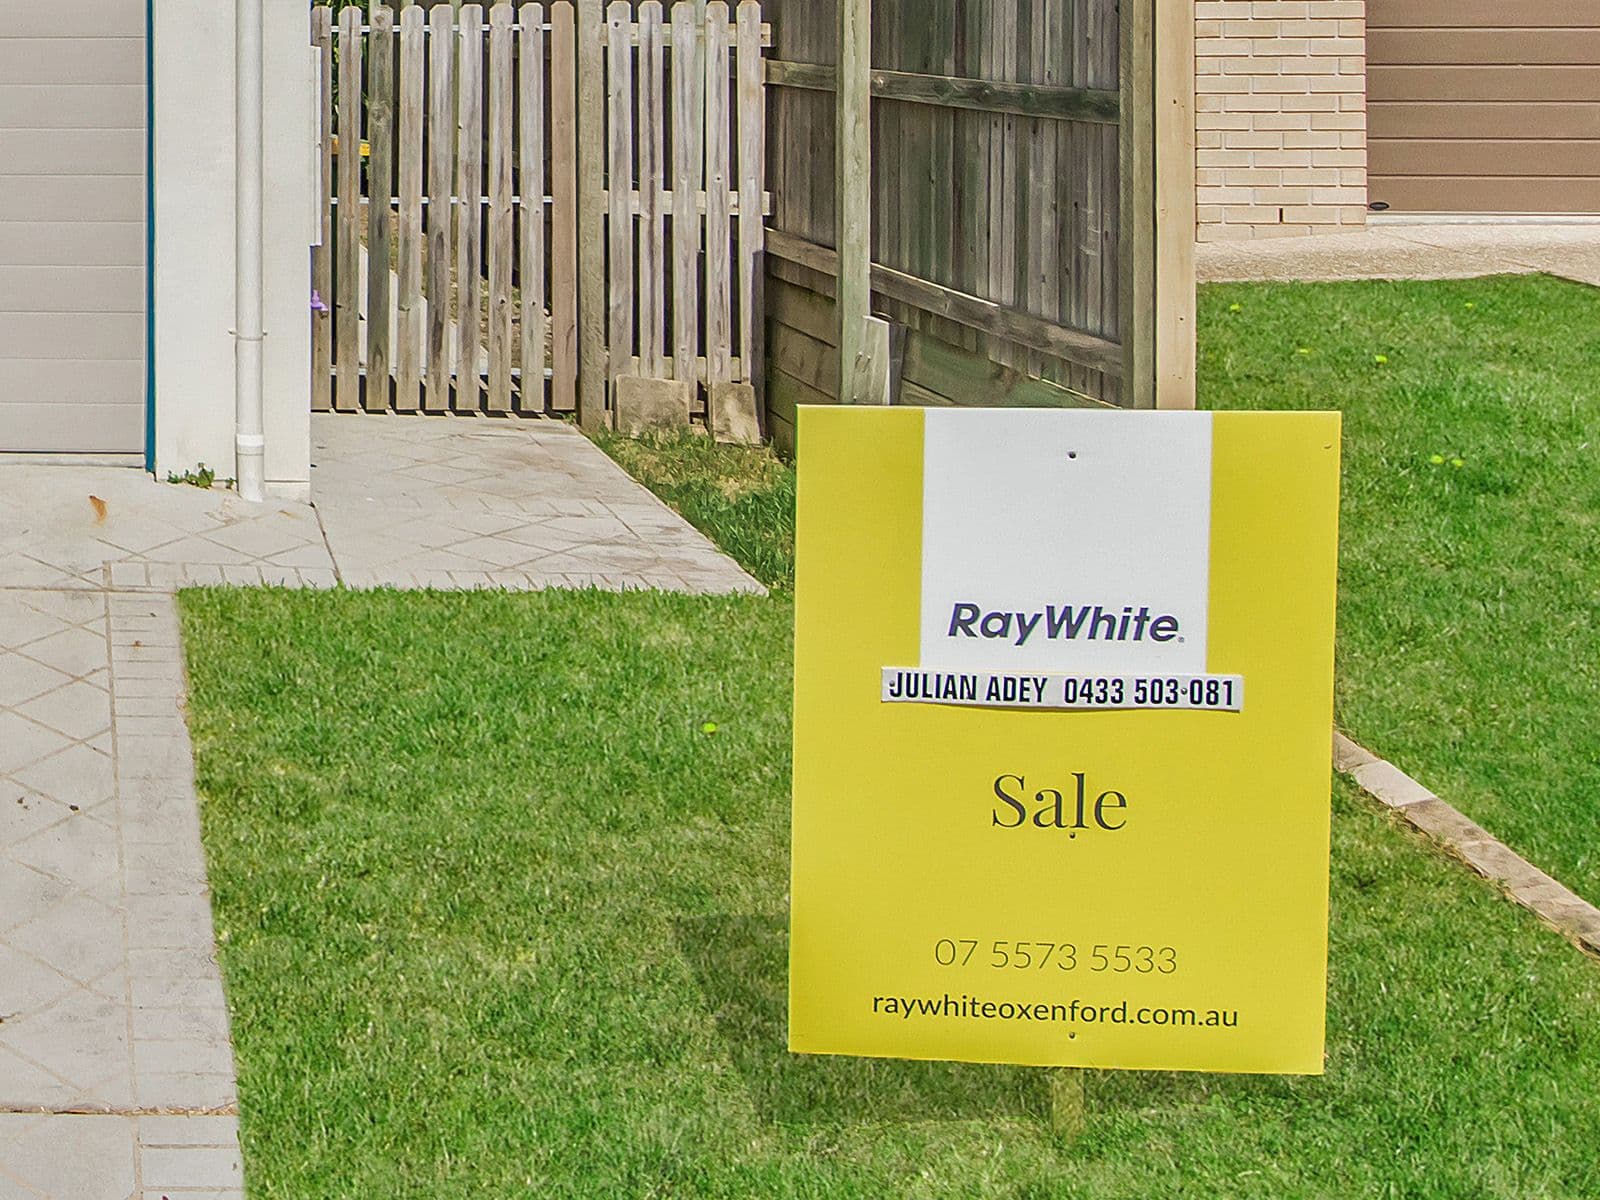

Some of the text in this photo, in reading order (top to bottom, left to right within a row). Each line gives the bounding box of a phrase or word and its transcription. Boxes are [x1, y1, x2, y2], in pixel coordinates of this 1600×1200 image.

[889, 672, 977, 700] JULIAN
[986, 676, 1048, 703] ADEY
[1064, 678, 1124, 704] 0433
[991, 773, 1127, 831] Sale
[935, 939, 1177, 974] 07 5573 5533
[872, 994, 1239, 1027] raywhiteoxenford.com.au
